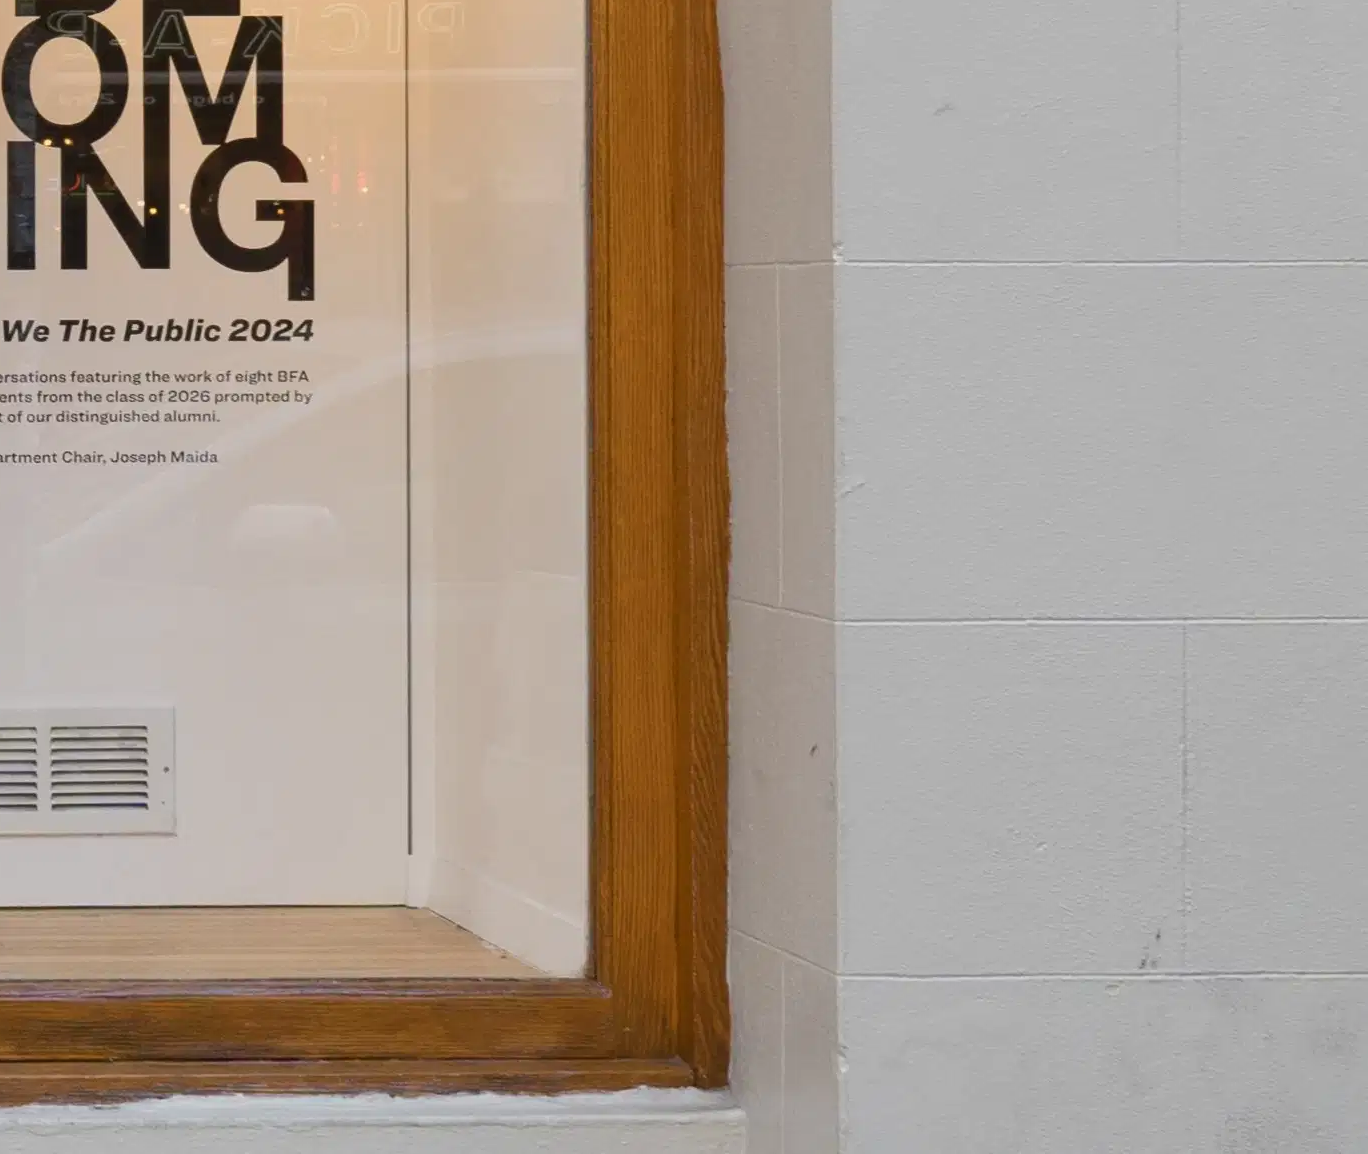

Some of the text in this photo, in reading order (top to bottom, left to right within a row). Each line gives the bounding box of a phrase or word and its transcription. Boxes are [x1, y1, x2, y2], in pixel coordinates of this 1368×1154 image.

[6, 136, 315, 302] ING
[2, 318, 315, 343] We The Public 2024
[70, 370, 142, 386] featuring
[144, 370, 171, 383] the
[174, 369, 213, 383] work
[215, 370, 232, 383] of
[234, 370, 274, 385] eight
[277, 370, 310, 383] BFA
[36, 390, 73, 404] from
[77, 390, 103, 403] the
[105, 389, 145, 403] class
[148, 389, 165, 403] of
[167, 389, 211, 403] 2026
[214, 390, 290, 405] prompted
[294, 389, 313, 405] by
[6, 410, 23, 424] of
[26, 413, 53, 423] our
[55, 409, 160, 426] distinguished
[163, 410, 221, 423] alumni.
[61, 450, 107, 464] Chair,
[109, 450, 167, 465] Joseph
[170, 450, 218, 463] Maida
